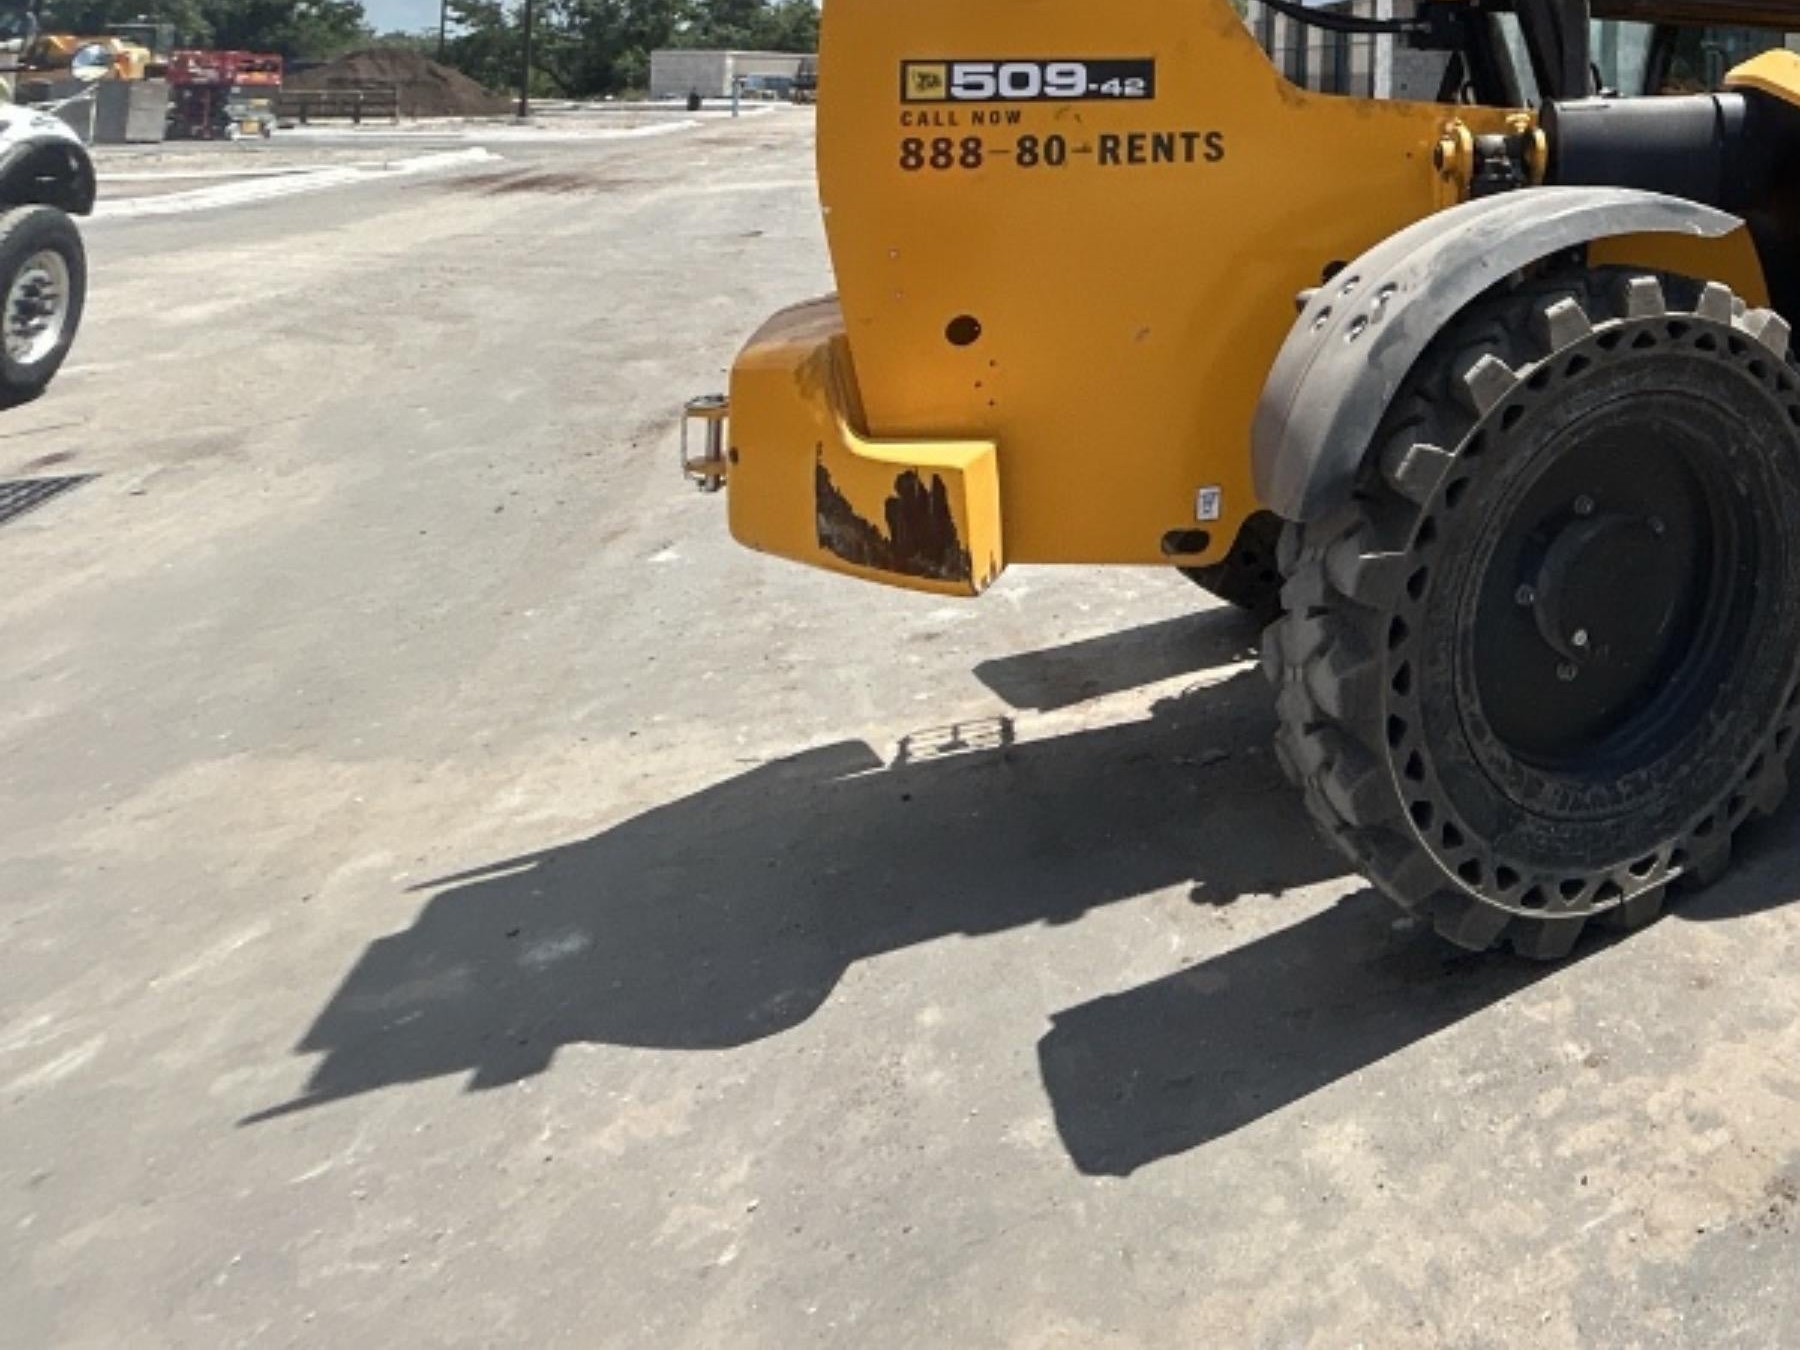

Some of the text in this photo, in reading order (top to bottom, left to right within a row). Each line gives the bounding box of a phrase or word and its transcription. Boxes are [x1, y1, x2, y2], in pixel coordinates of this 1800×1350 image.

[950, 62, 1147, 99] 509-42
[901, 109, 1022, 127] CALL NOW
